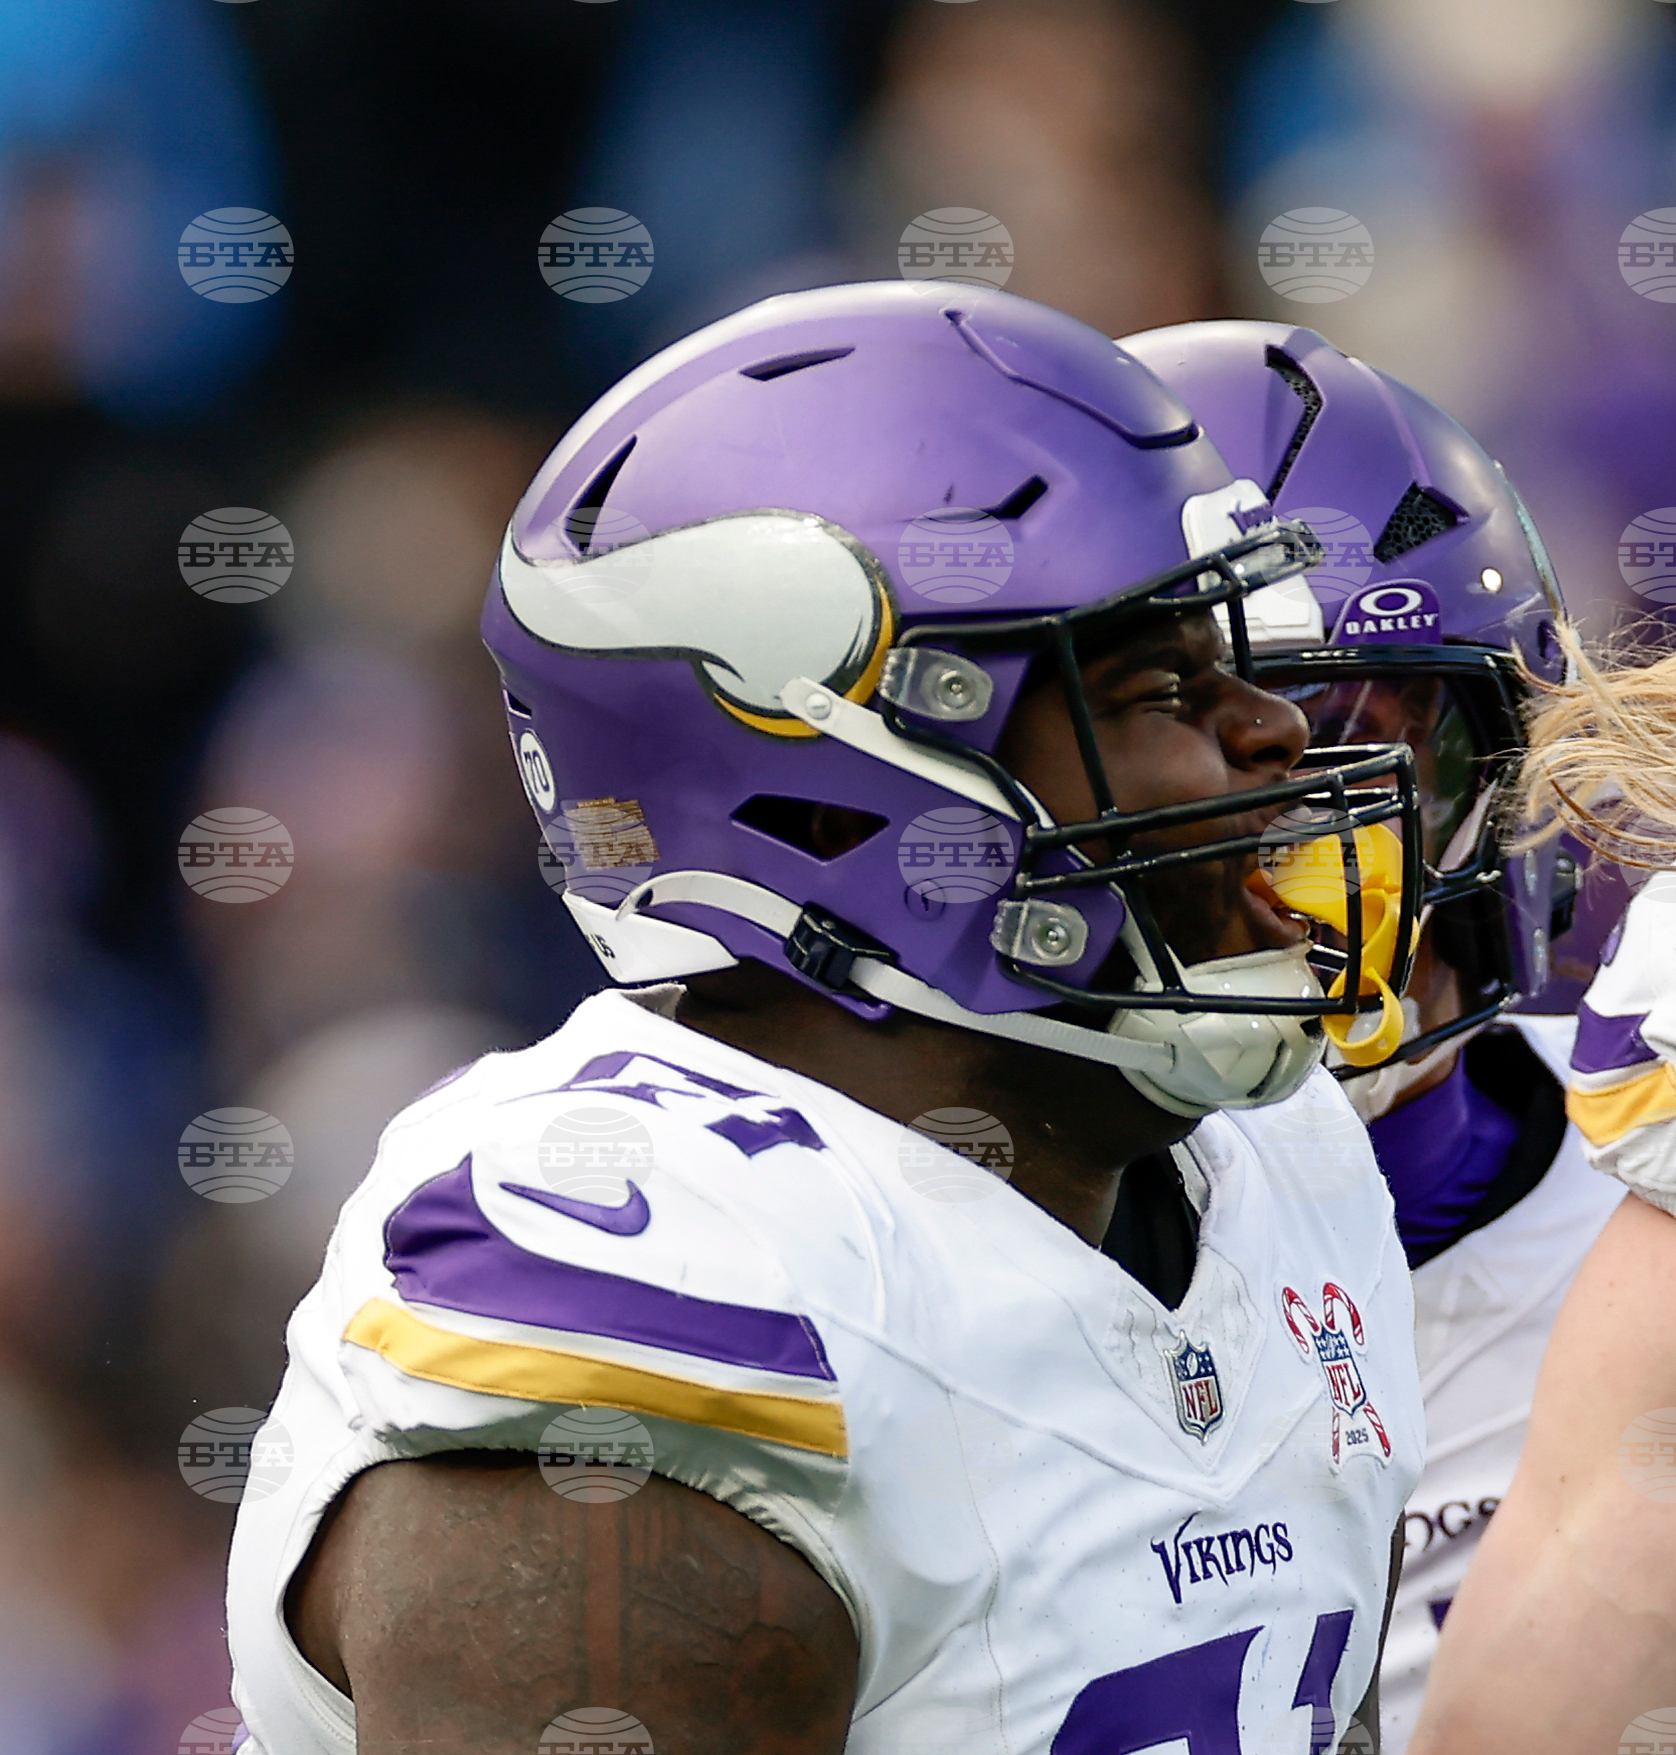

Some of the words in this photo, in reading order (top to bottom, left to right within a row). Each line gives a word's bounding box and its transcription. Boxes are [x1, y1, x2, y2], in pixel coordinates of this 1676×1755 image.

[1346, 613, 1437, 635] OAKLEY
[1326, 1362, 1363, 1407] NFL
[1182, 1379, 1220, 1424] NFL
[1344, 1427, 1371, 1447] 2025
